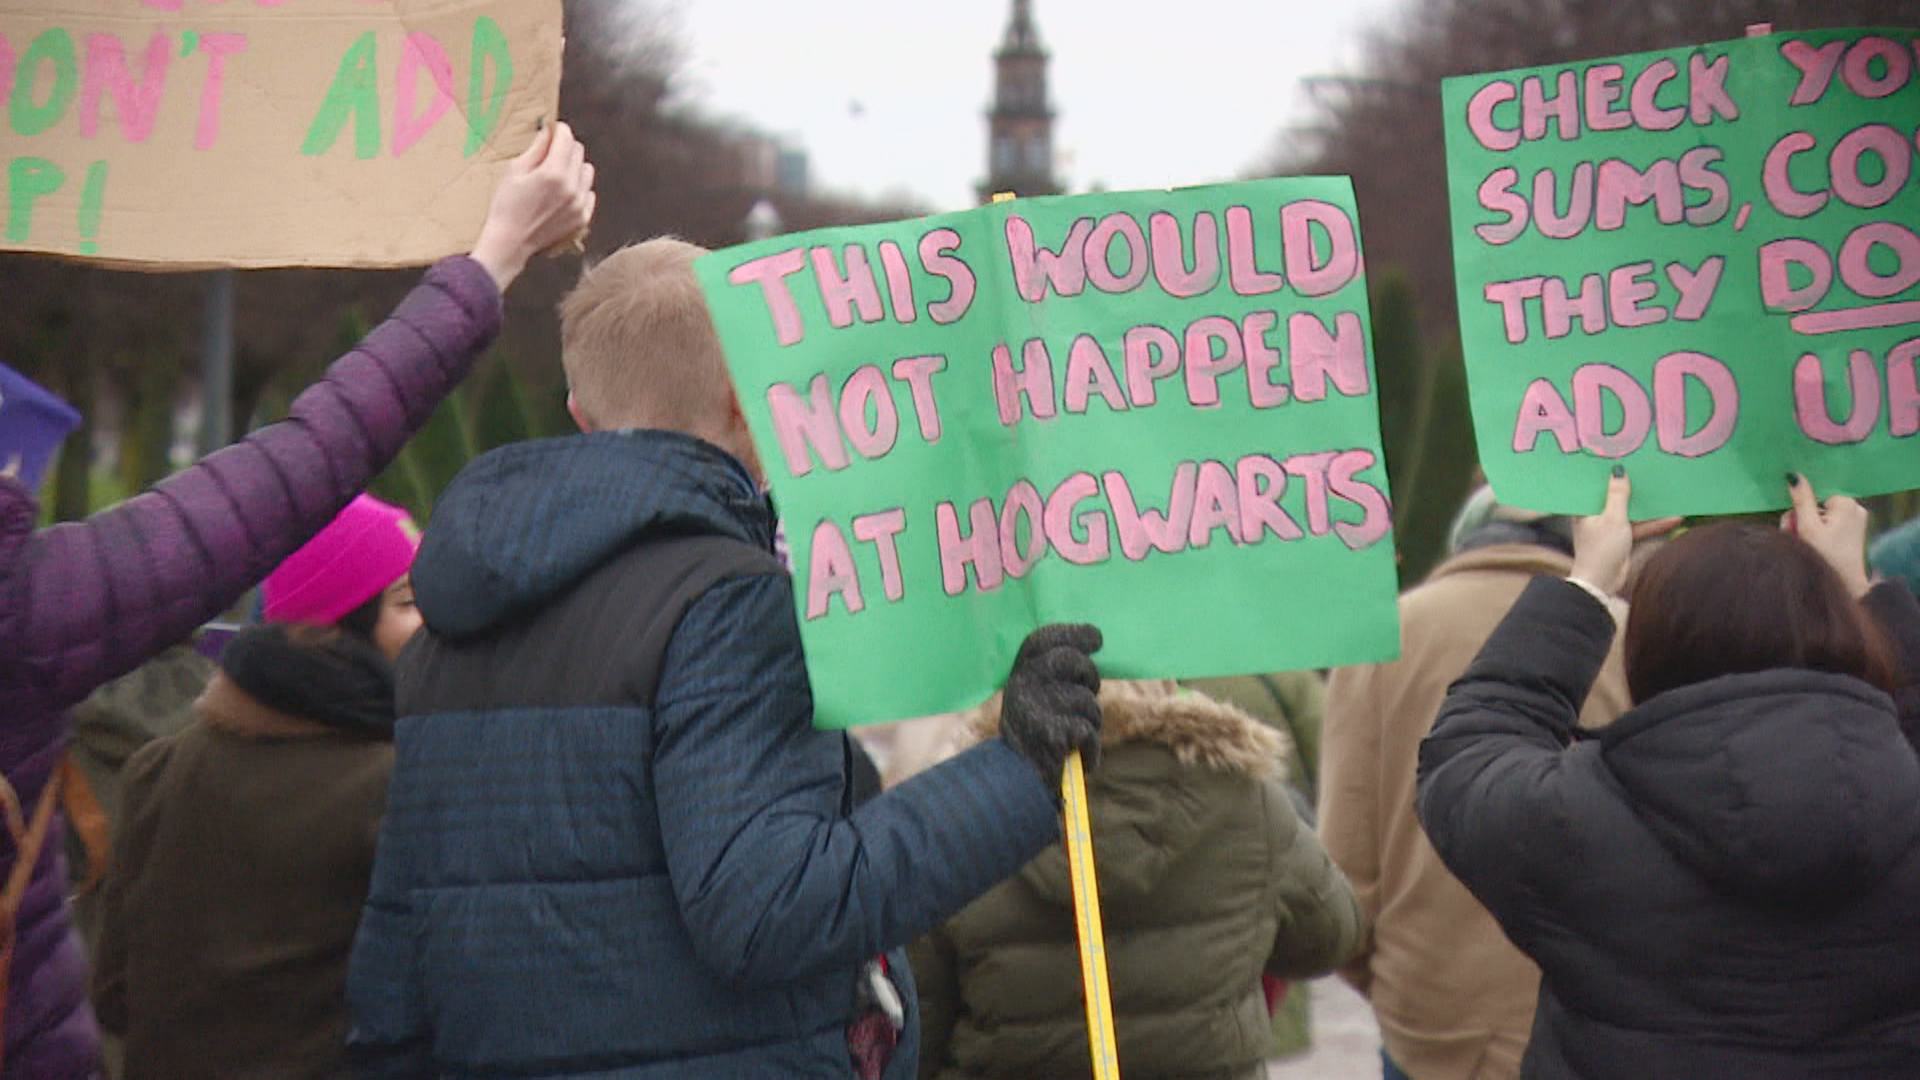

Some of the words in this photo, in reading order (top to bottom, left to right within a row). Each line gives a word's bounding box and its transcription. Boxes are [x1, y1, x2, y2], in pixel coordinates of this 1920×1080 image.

[0, 27, 248, 151] ON'T
[300, 15, 513, 159] ADD
[1466, 52, 1740, 151] CHECK
[1778, 35, 1920, 107] YO
[1474, 145, 1752, 245] SUMS,
[1761, 123, 1920, 218] CO
[728, 228, 977, 346] THIS
[1005, 200, 1358, 302] WOULD
[1484, 256, 1725, 344] THEY
[766, 355, 947, 476] NOT
[992, 311, 1370, 426] HAPPEN
[1512, 351, 1739, 458] ADD
[806, 508, 905, 621] AT
[936, 448, 1393, 597] HOGWARTS
